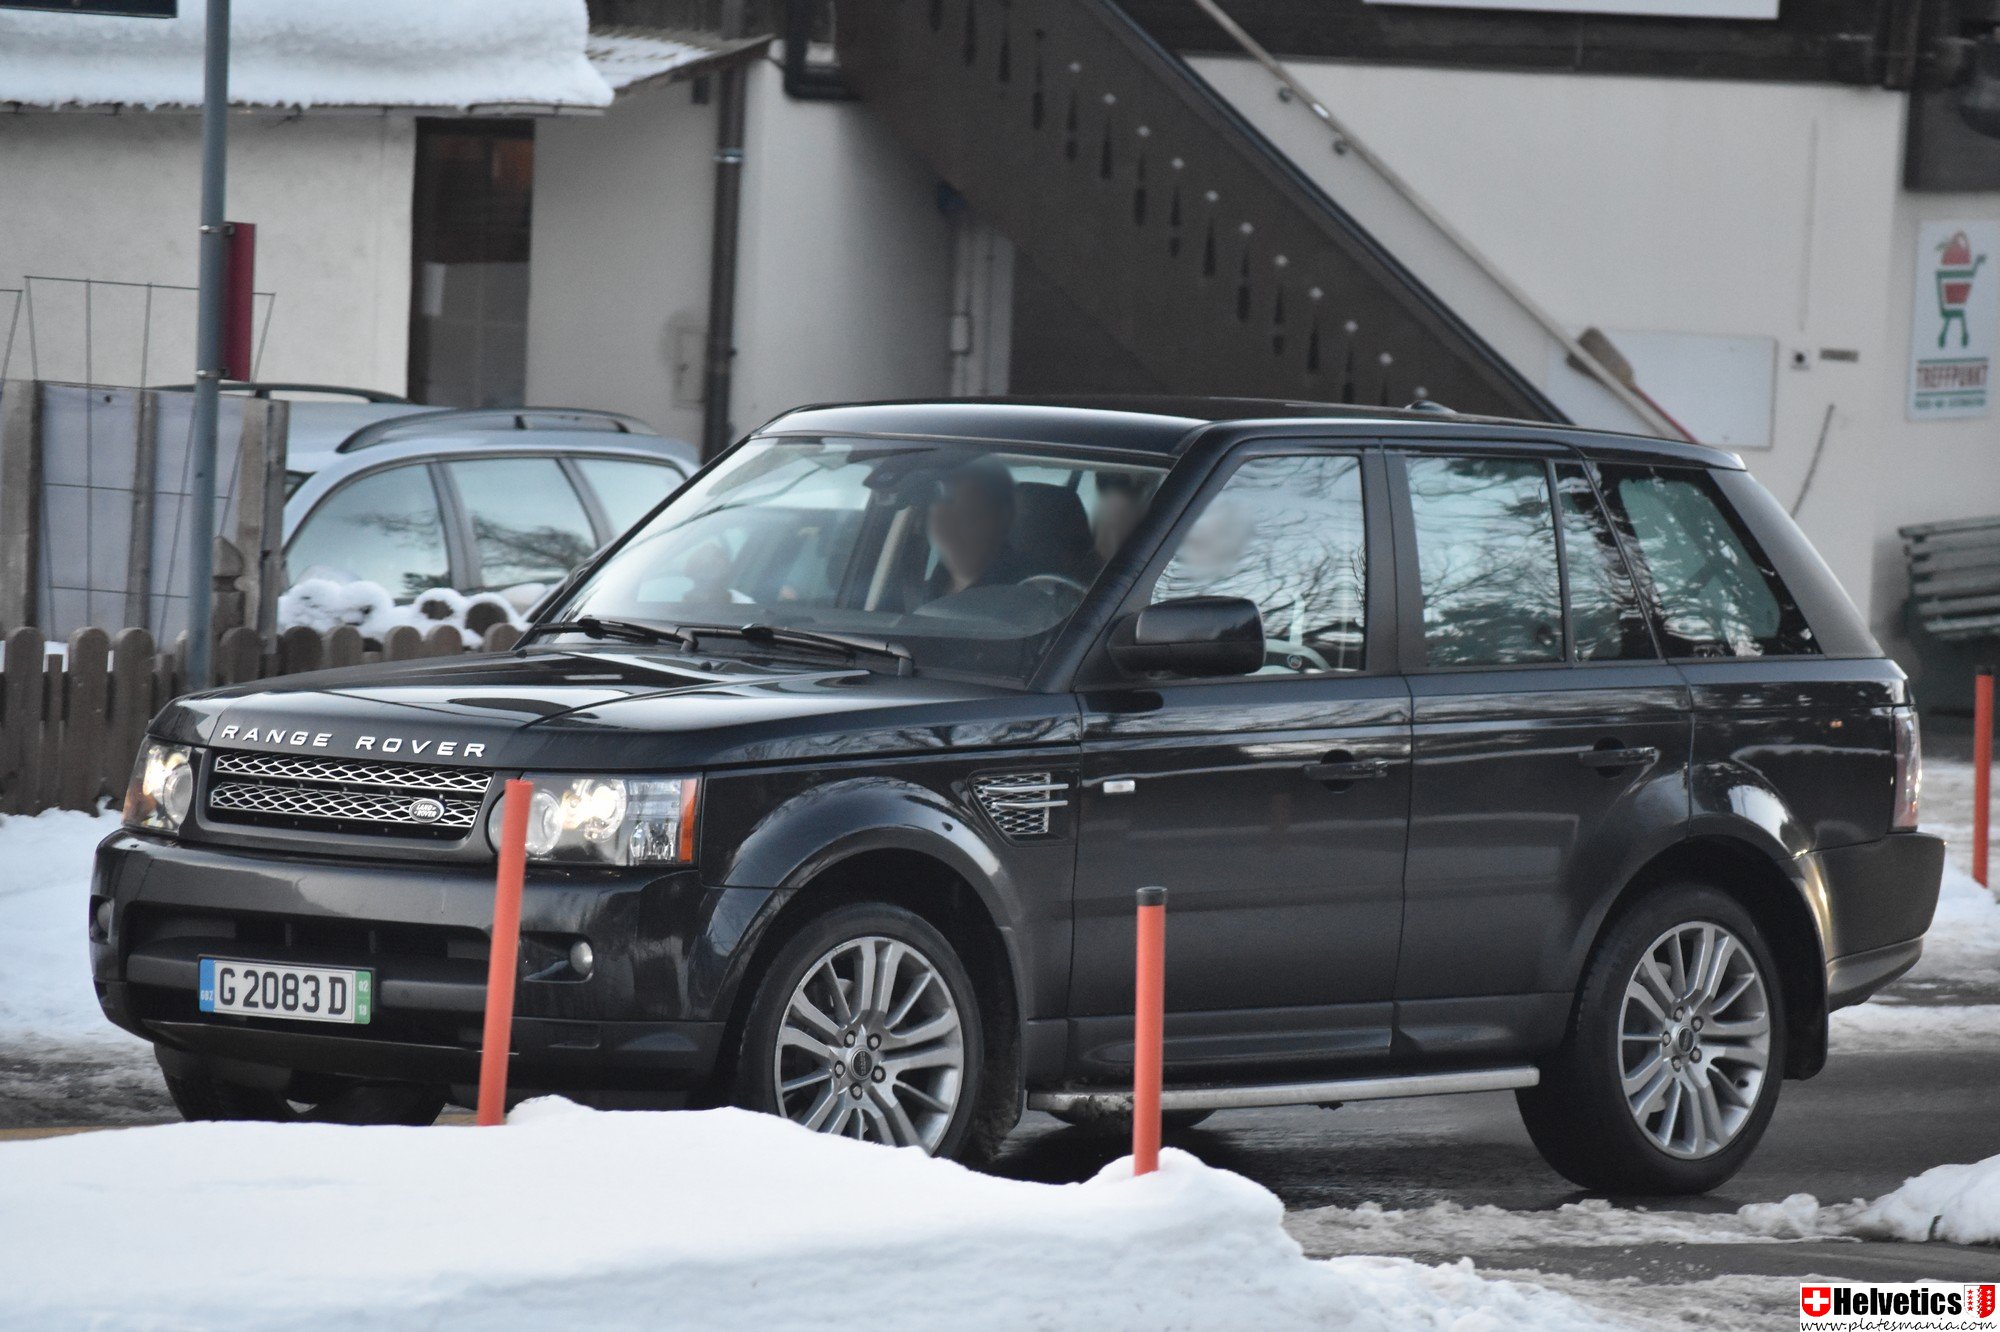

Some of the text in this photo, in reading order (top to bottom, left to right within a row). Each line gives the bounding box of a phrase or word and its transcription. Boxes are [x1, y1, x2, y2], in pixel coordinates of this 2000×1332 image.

[221, 725, 486, 758] RANGE ROVER
[416, 803, 433, 811] LAND
[416, 810, 437, 818] ROVER
